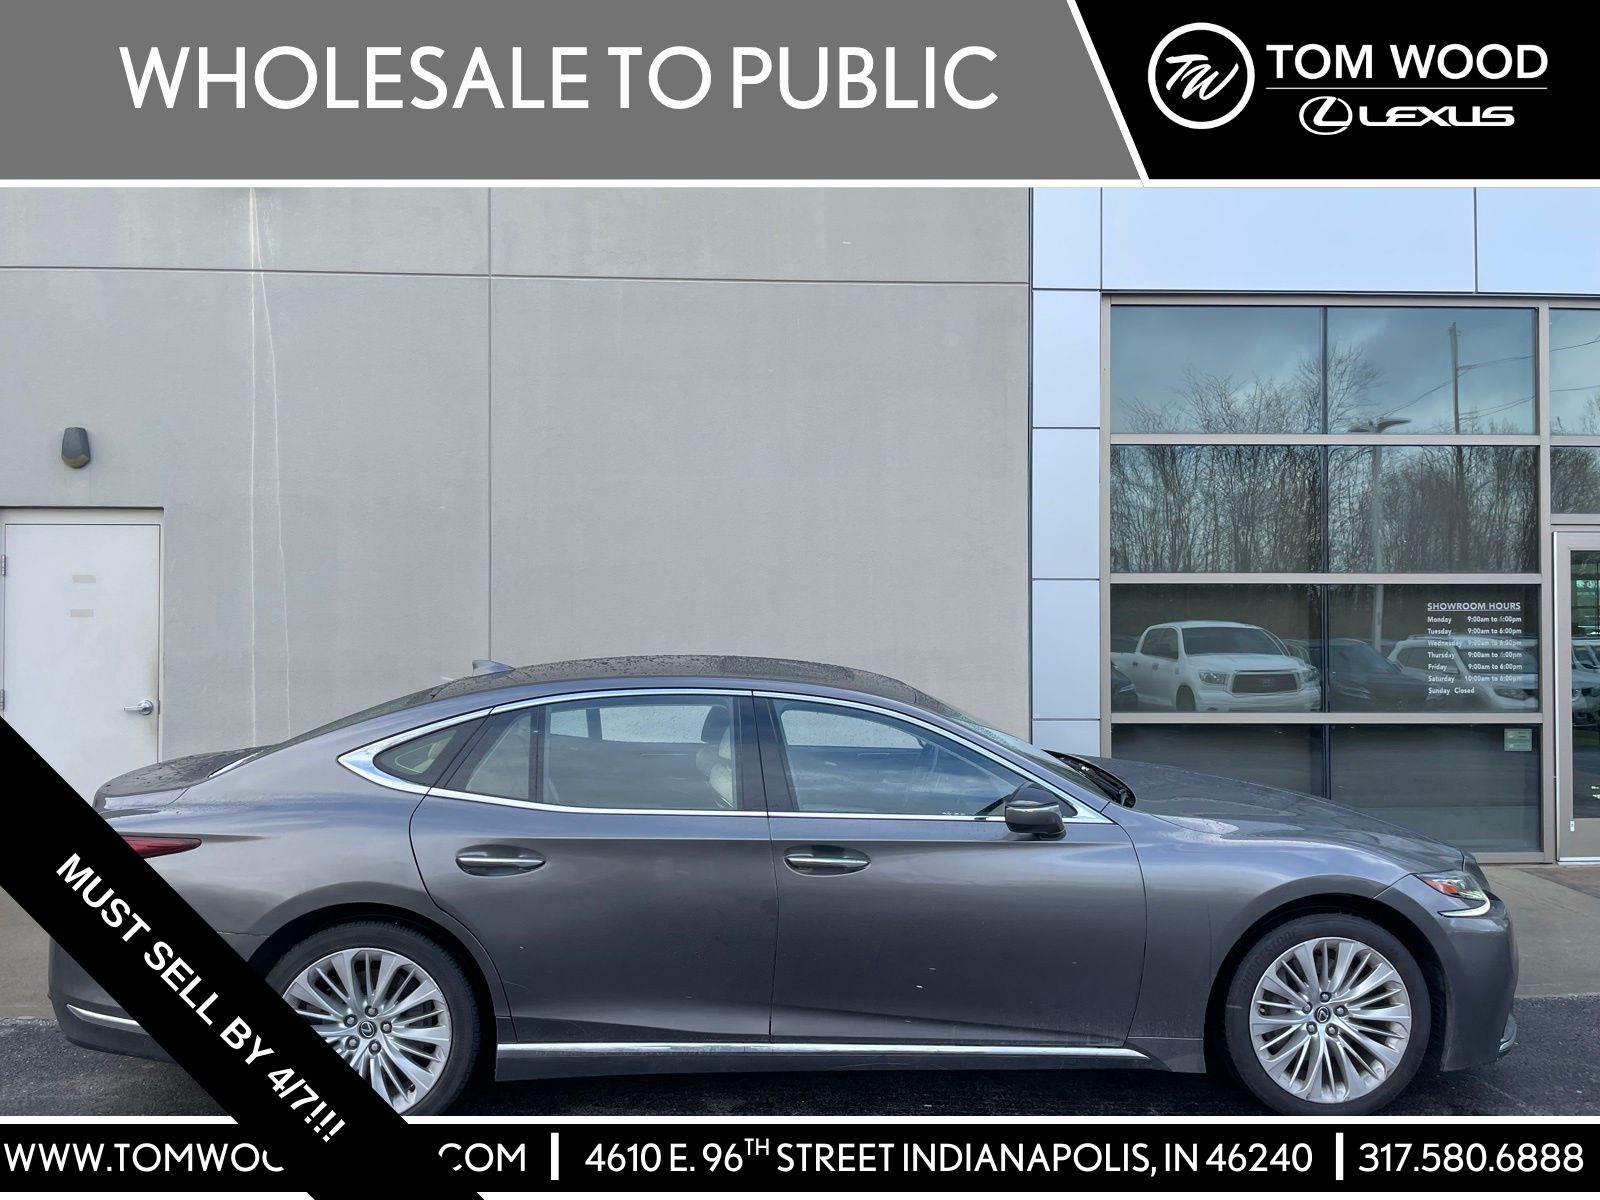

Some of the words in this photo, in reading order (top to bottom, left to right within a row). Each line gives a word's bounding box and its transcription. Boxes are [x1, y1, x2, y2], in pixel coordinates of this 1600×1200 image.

[1427, 602, 1486, 610] SHOWROOM
[1488, 602, 1521, 610] HOURS
[1427, 616, 1452, 624] Monday
[1427, 628, 1452, 636] Tuesday
[1427, 640, 1463, 648] Wednesday
[1428, 664, 1447, 672] Friday
[1428, 675, 1455, 683] Saturday
[1428, 687, 1450, 695] Sunday
